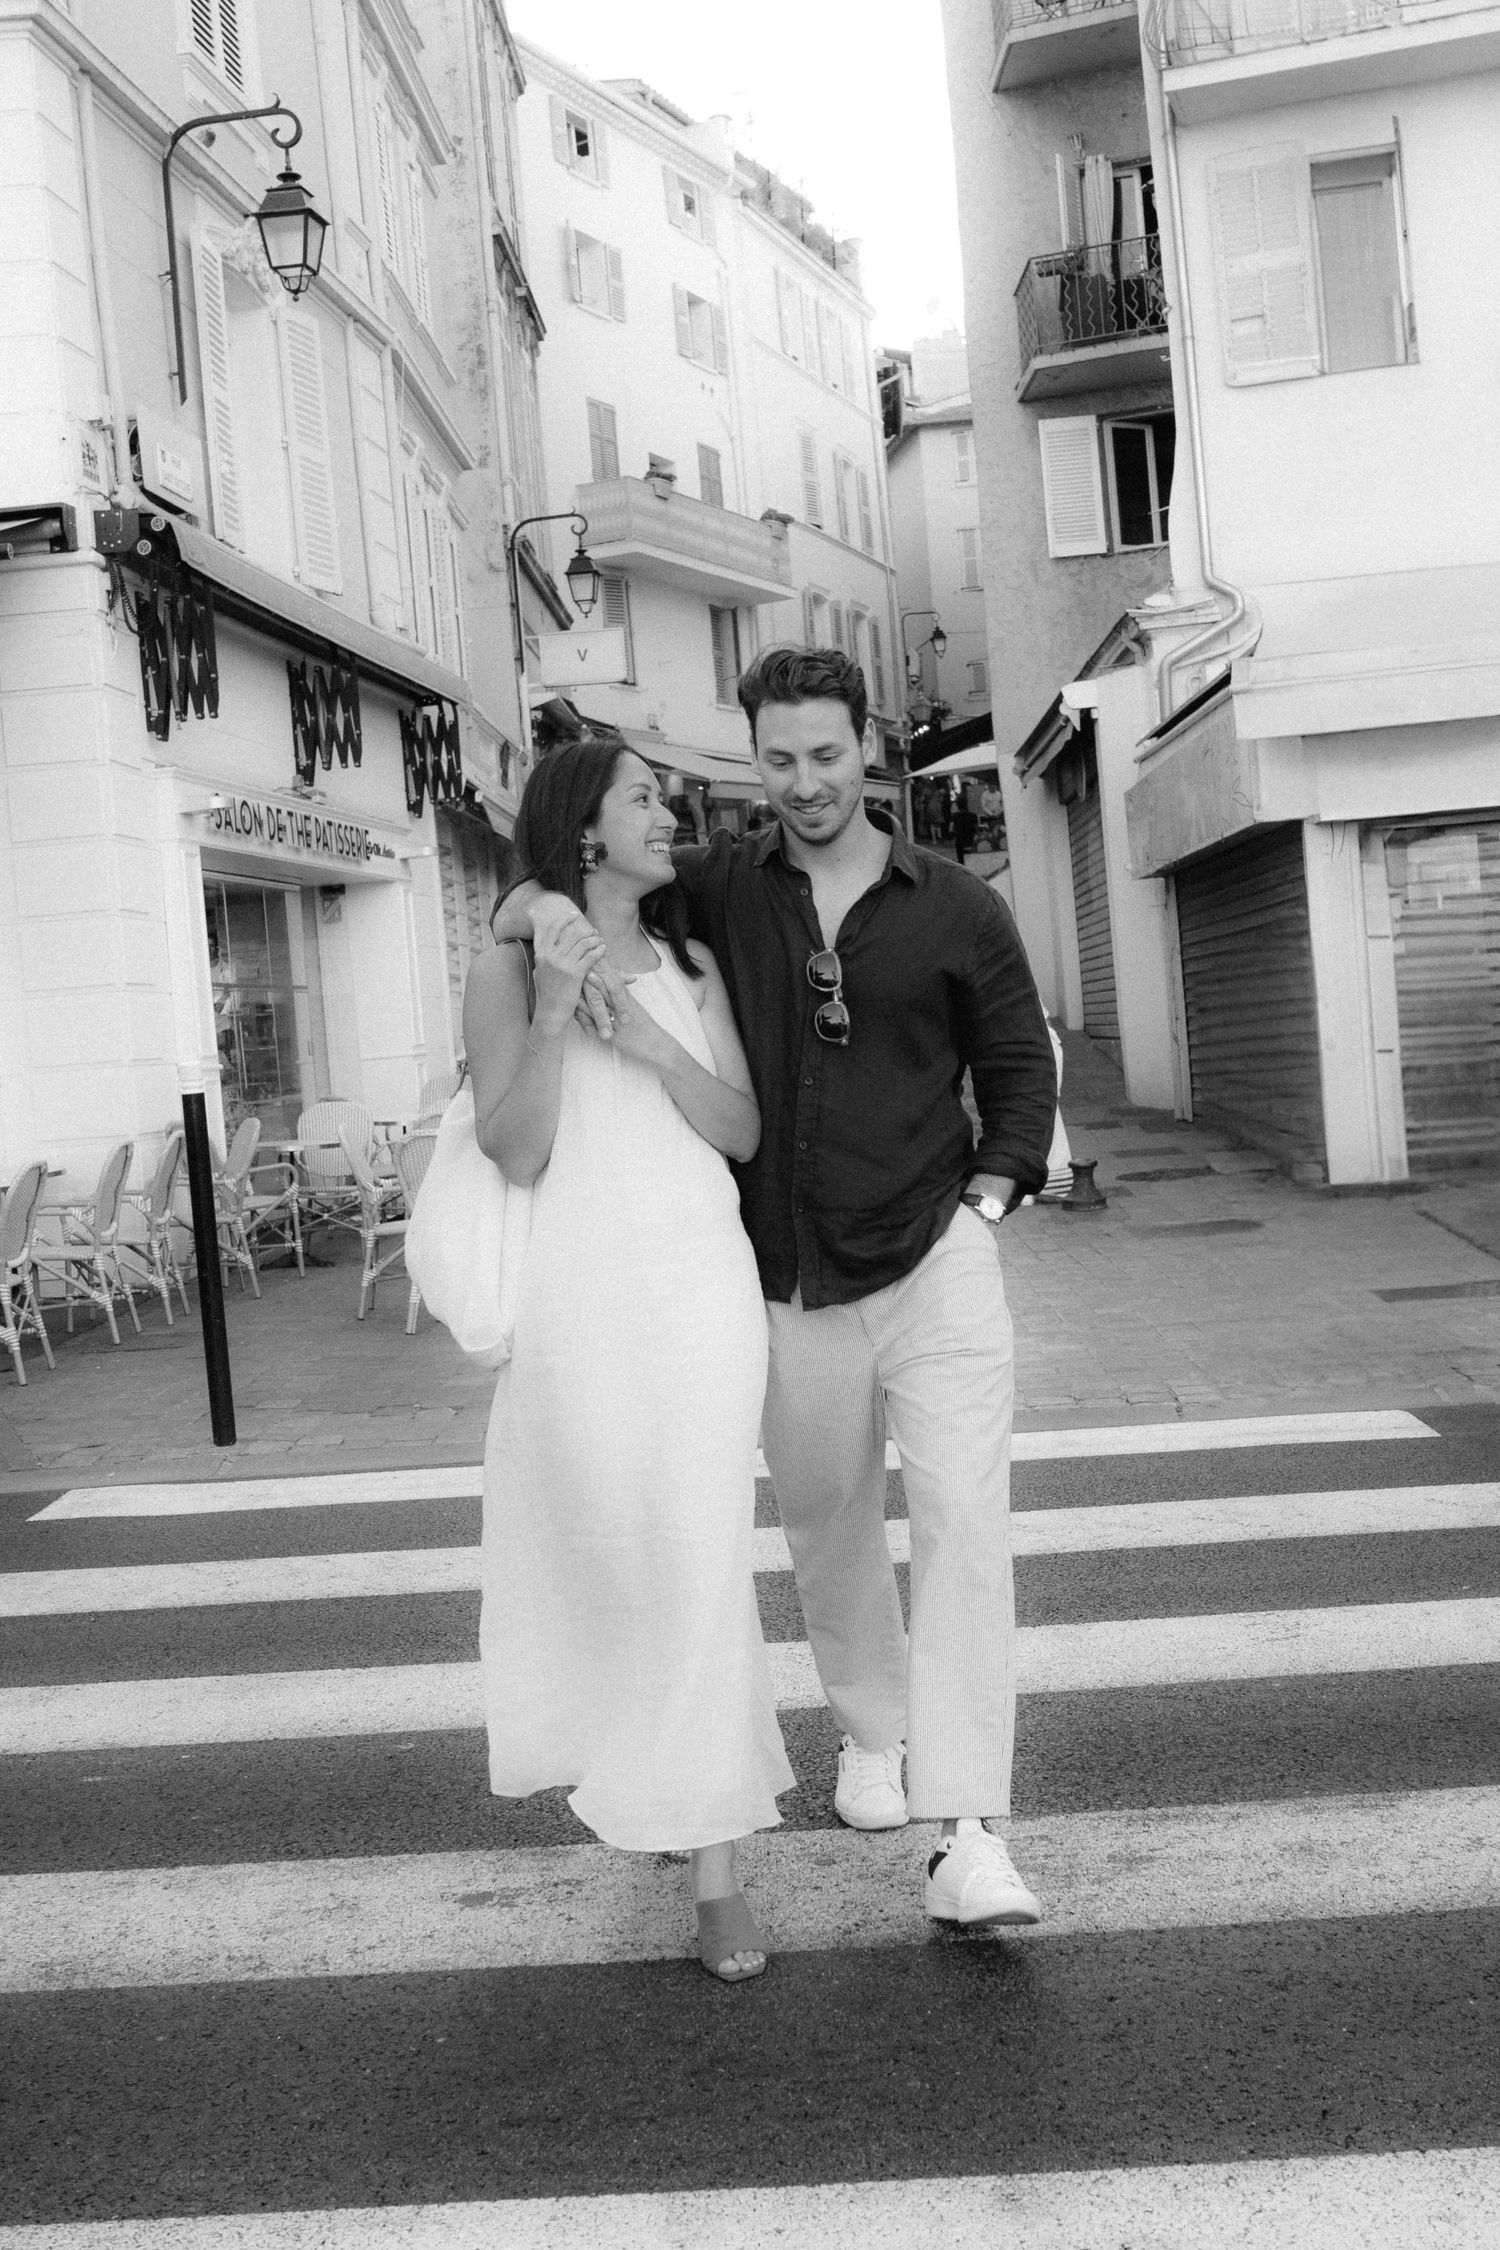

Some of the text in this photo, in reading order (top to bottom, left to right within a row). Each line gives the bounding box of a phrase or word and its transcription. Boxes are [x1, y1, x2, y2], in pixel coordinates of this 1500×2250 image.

[576, 648, 588, 662] V
[215, 797, 263, 837] SALON
[266, 805, 284, 843] DE
[315, 816, 370, 860] PATISSERIE
